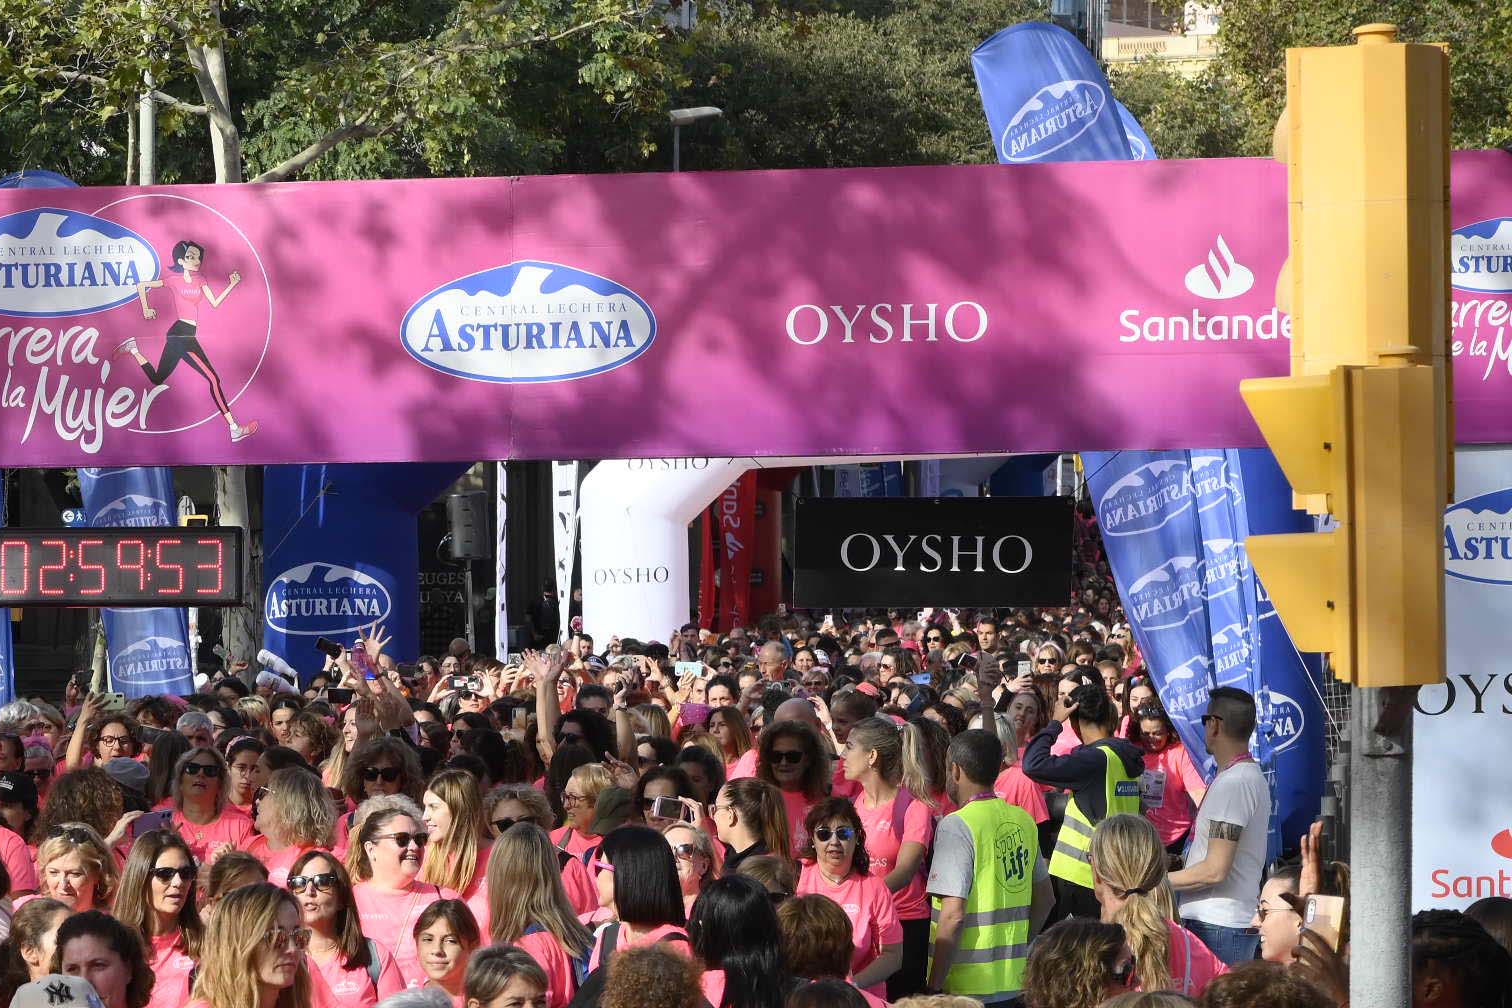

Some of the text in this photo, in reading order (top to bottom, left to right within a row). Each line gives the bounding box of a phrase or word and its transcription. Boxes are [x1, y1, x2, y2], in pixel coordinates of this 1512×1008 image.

[63, 244, 135, 256] LECHERA
[460, 301, 628, 316] CENTRAL LECHERA
[785, 301, 988, 345] OYSHO
[420, 308, 637, 353] ASTURIANA
[1119, 306, 1293, 343] Santande
[1, 368, 26, 408] la
[20, 359, 170, 454] Mujer
[0, 539, 223, 595] 02:59:53
[840, 532, 1033, 574] OYSHO
[326, 587, 377, 596] LECHERA
[416, 572, 465, 585] EUGES
[593, 566, 670, 586] OYSHO
[269, 592, 381, 619] ASTURIANA
[995, 826, 1024, 860] Sport
[1431, 869, 1512, 898] Sant
